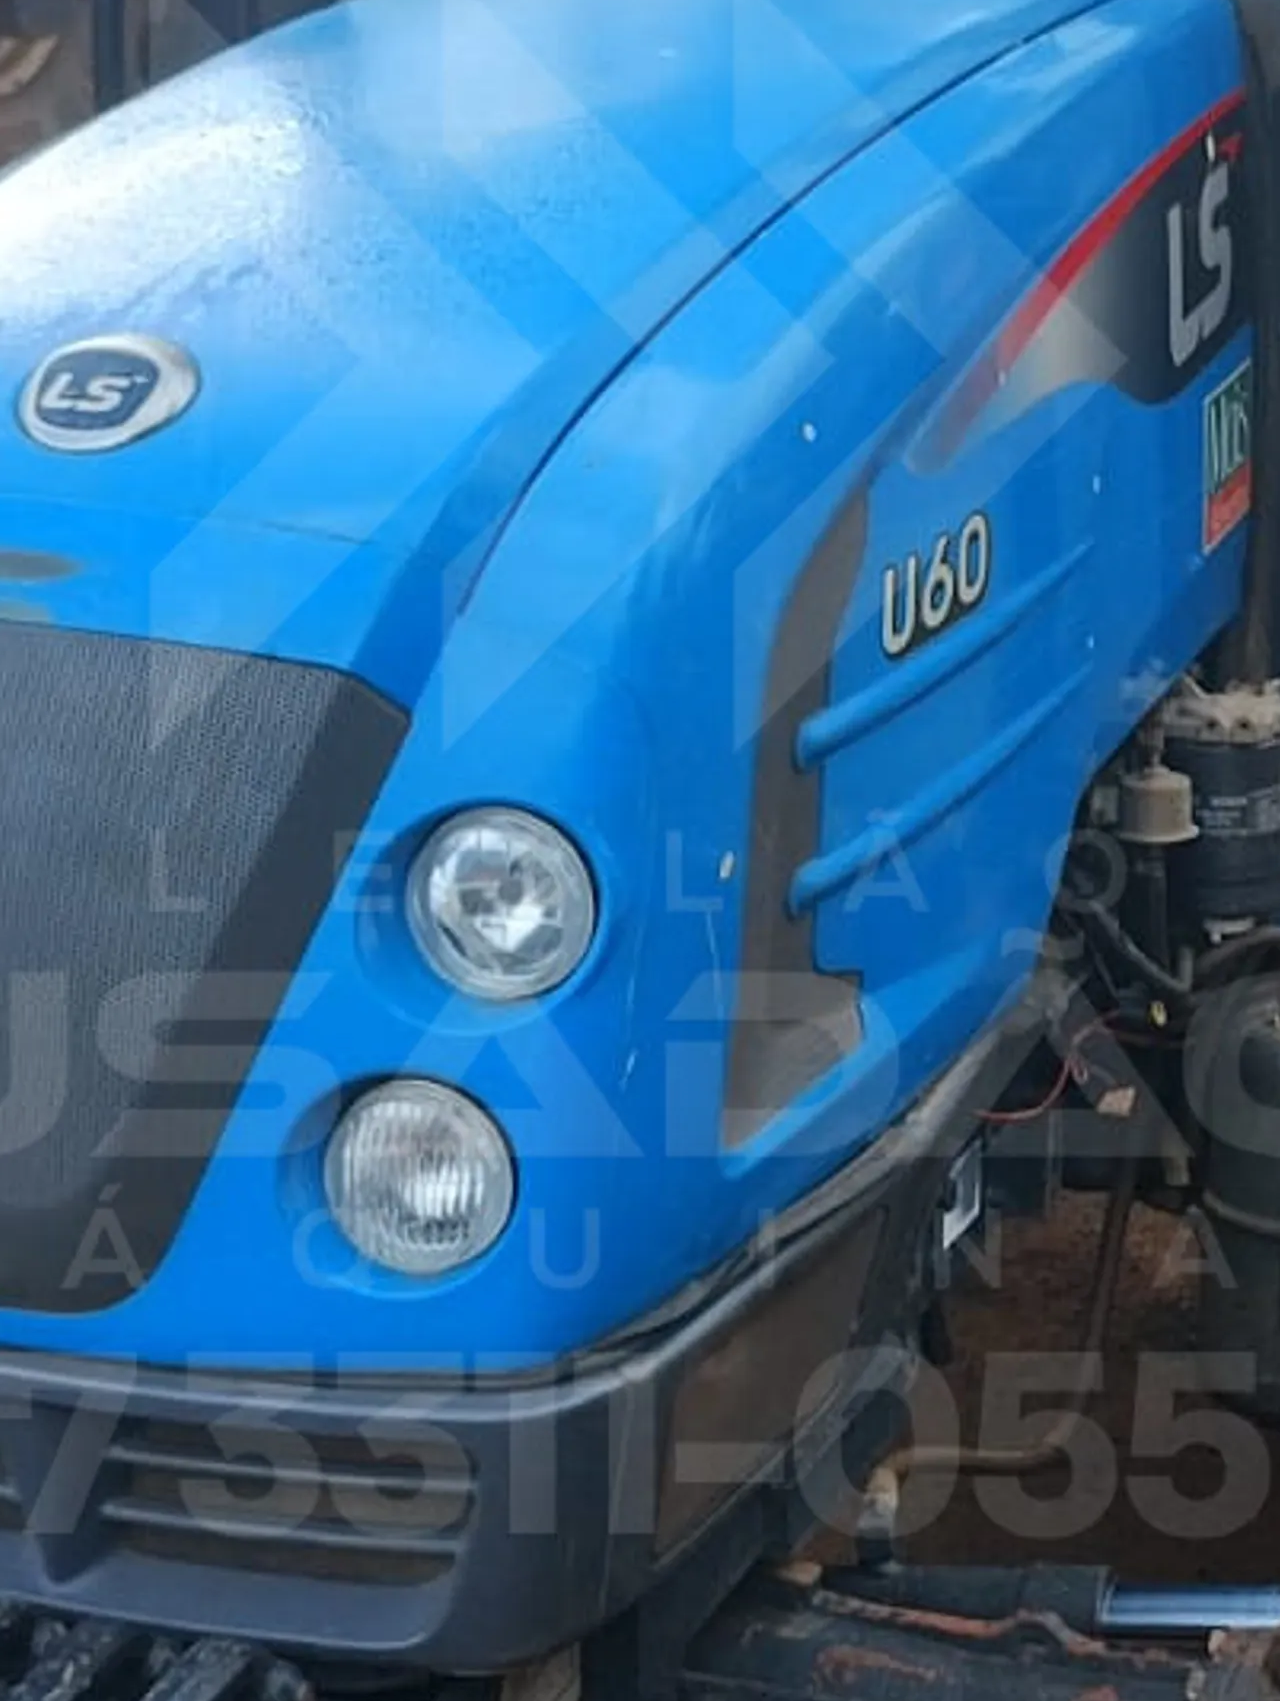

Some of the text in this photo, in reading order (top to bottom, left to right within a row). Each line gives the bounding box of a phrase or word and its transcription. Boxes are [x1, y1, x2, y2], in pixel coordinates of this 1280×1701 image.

[1167, 161, 1233, 367] LS
[38, 371, 132, 413] LS
[880, 513, 990, 656] U60
